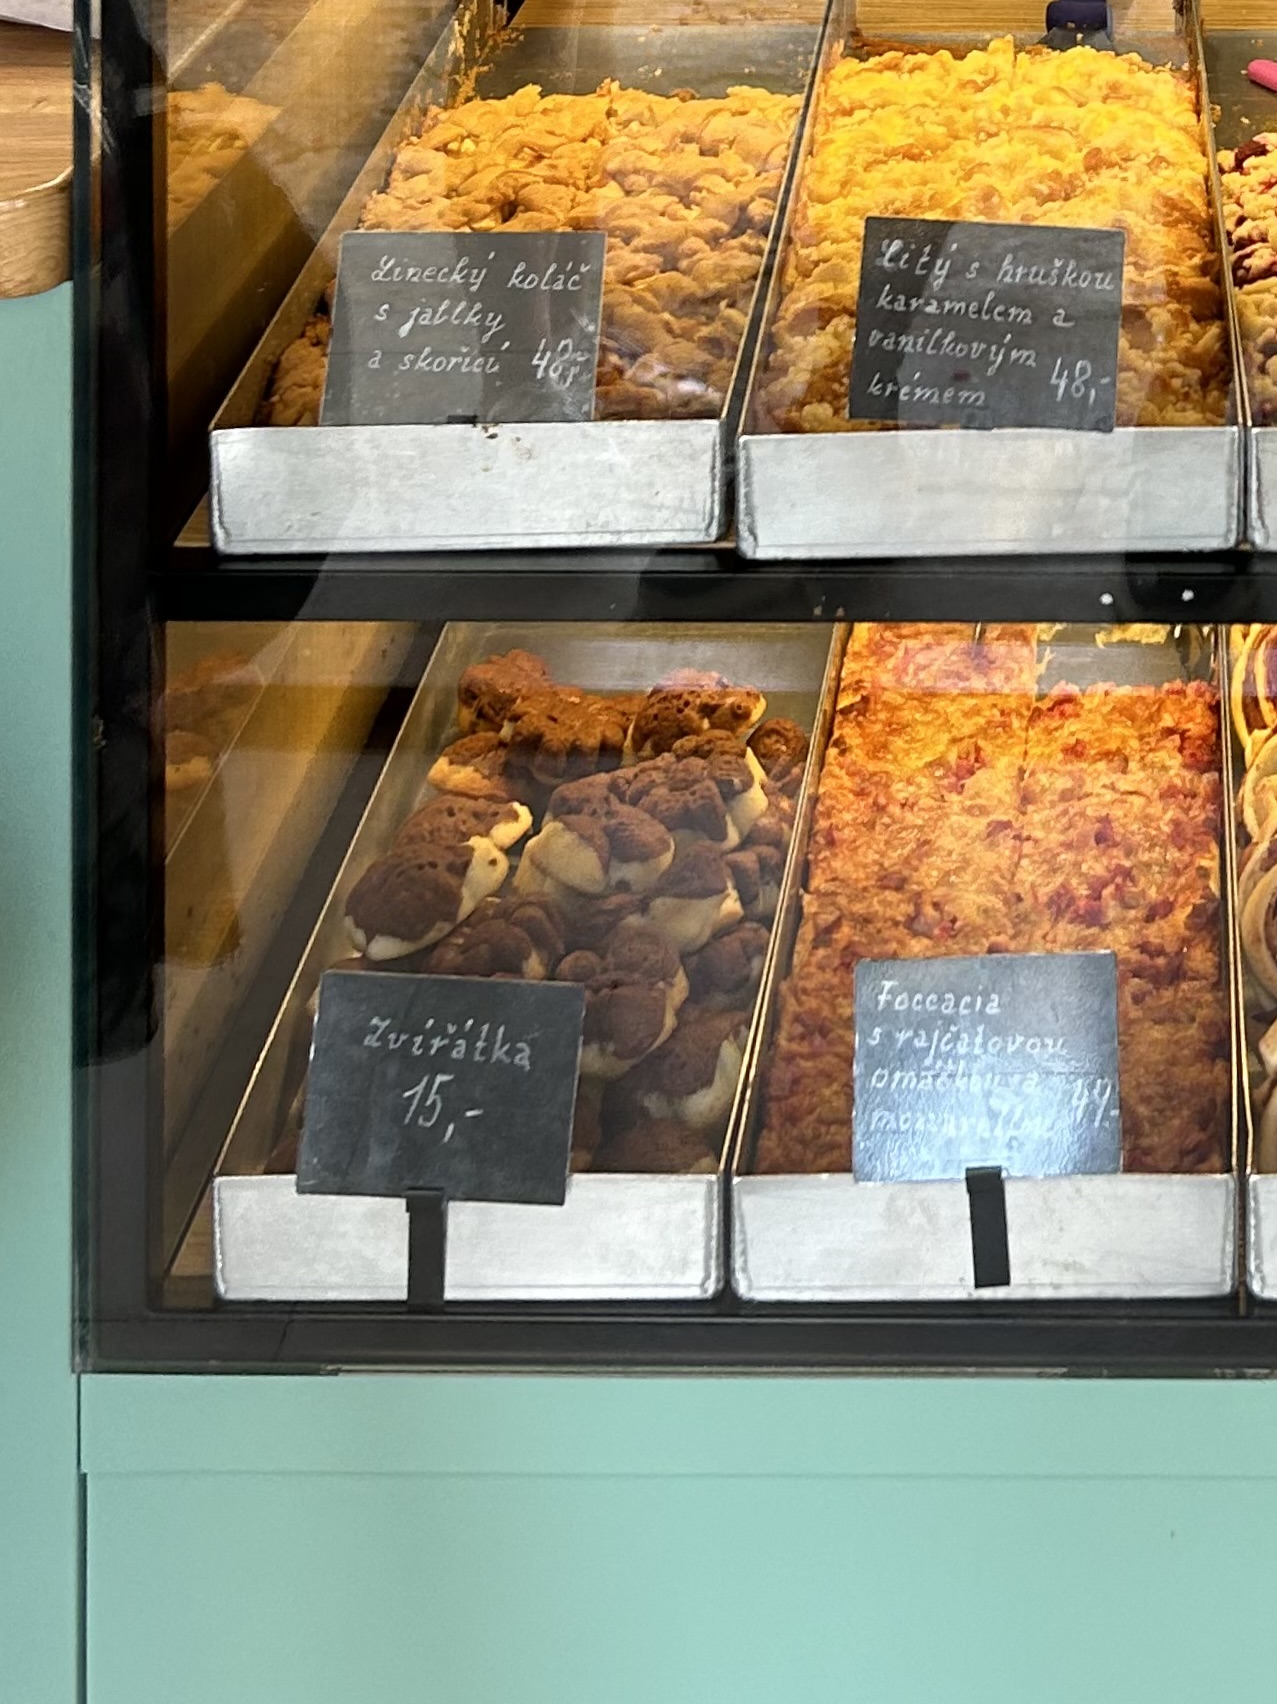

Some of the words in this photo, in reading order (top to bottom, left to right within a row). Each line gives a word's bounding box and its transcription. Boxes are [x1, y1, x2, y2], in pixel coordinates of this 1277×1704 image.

[370, 250, 496, 293] Linecký
[506, 260, 592, 292] koláč
[965, 260, 981, 279] s
[996, 252, 1116, 292] hruškou
[374, 302, 391, 322] s
[397, 297, 507, 344] jablky
[875, 283, 1034, 325] karamelem
[1052, 307, 1076, 328] a
[367, 348, 382, 371] a
[866, 327, 1038, 377] vanilkovým
[866, 371, 987, 408] krémem
[876, 979, 1001, 1016] Foccacia
[362, 1015, 533, 1072] Zvířátka
[867, 1026, 883, 1046] s
[895, 1020, 1069, 1067] rajčatovou
[402, 1071, 485, 1144] 15,-
